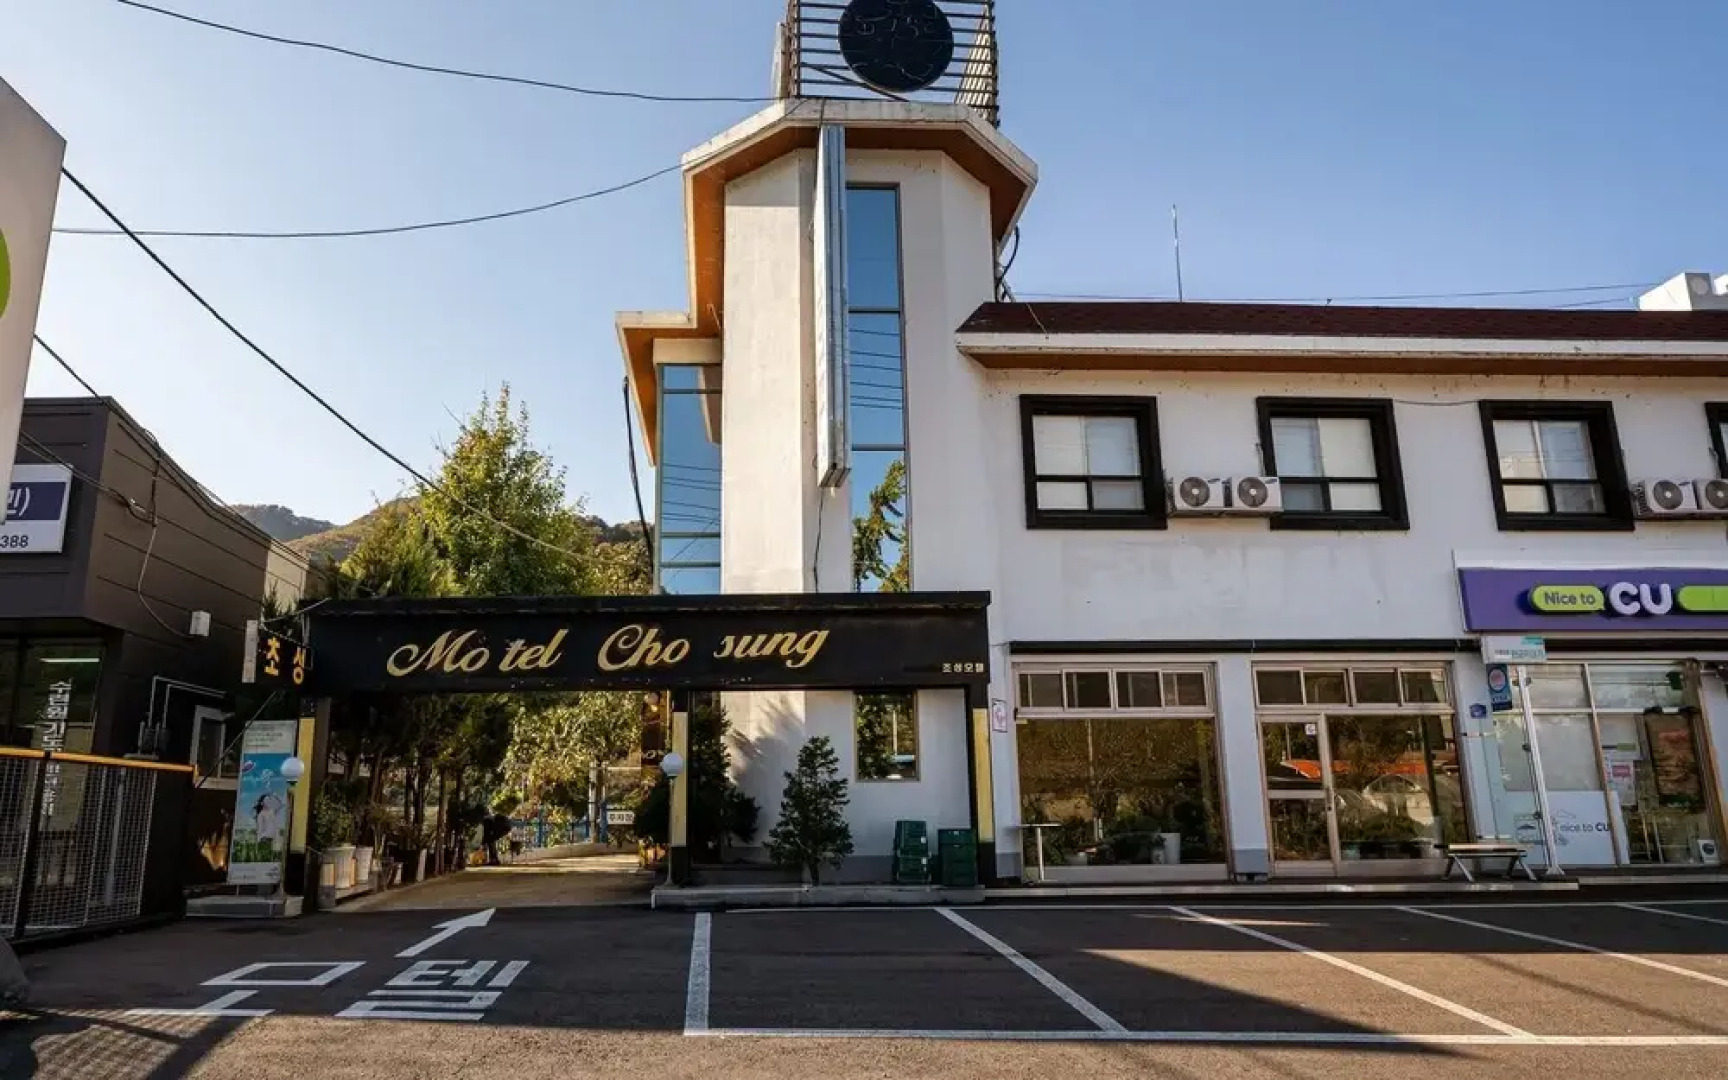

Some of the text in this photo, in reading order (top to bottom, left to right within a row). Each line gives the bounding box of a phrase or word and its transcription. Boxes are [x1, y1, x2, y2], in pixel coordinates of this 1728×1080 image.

[1544, 581, 1673, 615] Nice to CU
